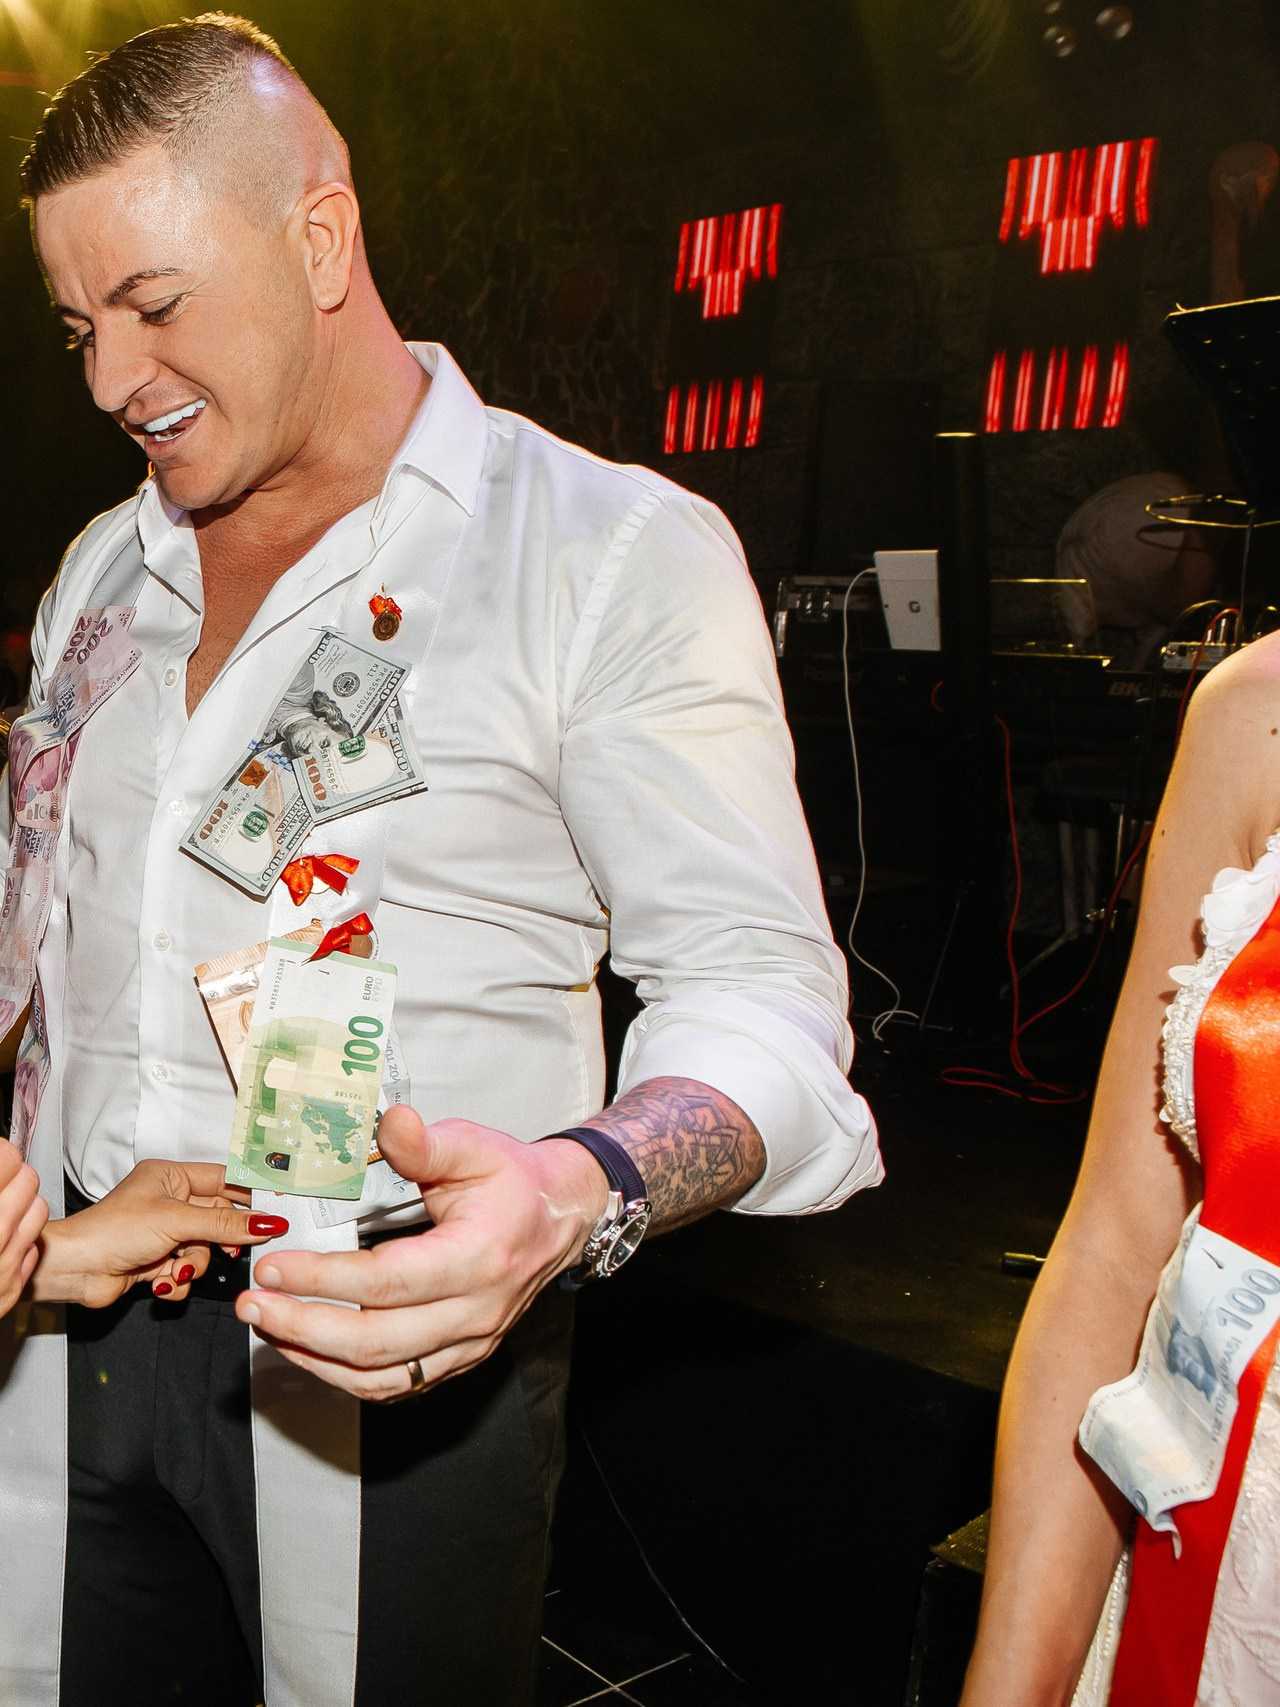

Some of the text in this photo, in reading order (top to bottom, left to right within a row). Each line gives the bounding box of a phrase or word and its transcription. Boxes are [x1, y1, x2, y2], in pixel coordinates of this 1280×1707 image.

[64, 618, 92, 663] 200
[75, 618, 114, 665] 200
[378, 667, 387, 677] PK
[379, 670, 402, 702] 100
[353, 677, 381, 713] 45597097
[389, 737, 409, 772] 100
[240, 792, 249, 802] PK
[304, 756, 328, 802] 100
[198, 800, 229, 842] 100
[217, 802, 242, 838] 45597097
[261, 849, 285, 883] 100
[1, 877, 15, 918] 200
[363, 976, 373, 1001] EURO
[341, 1015, 384, 1077] 100
[1219, 1268, 1280, 1332] 100
